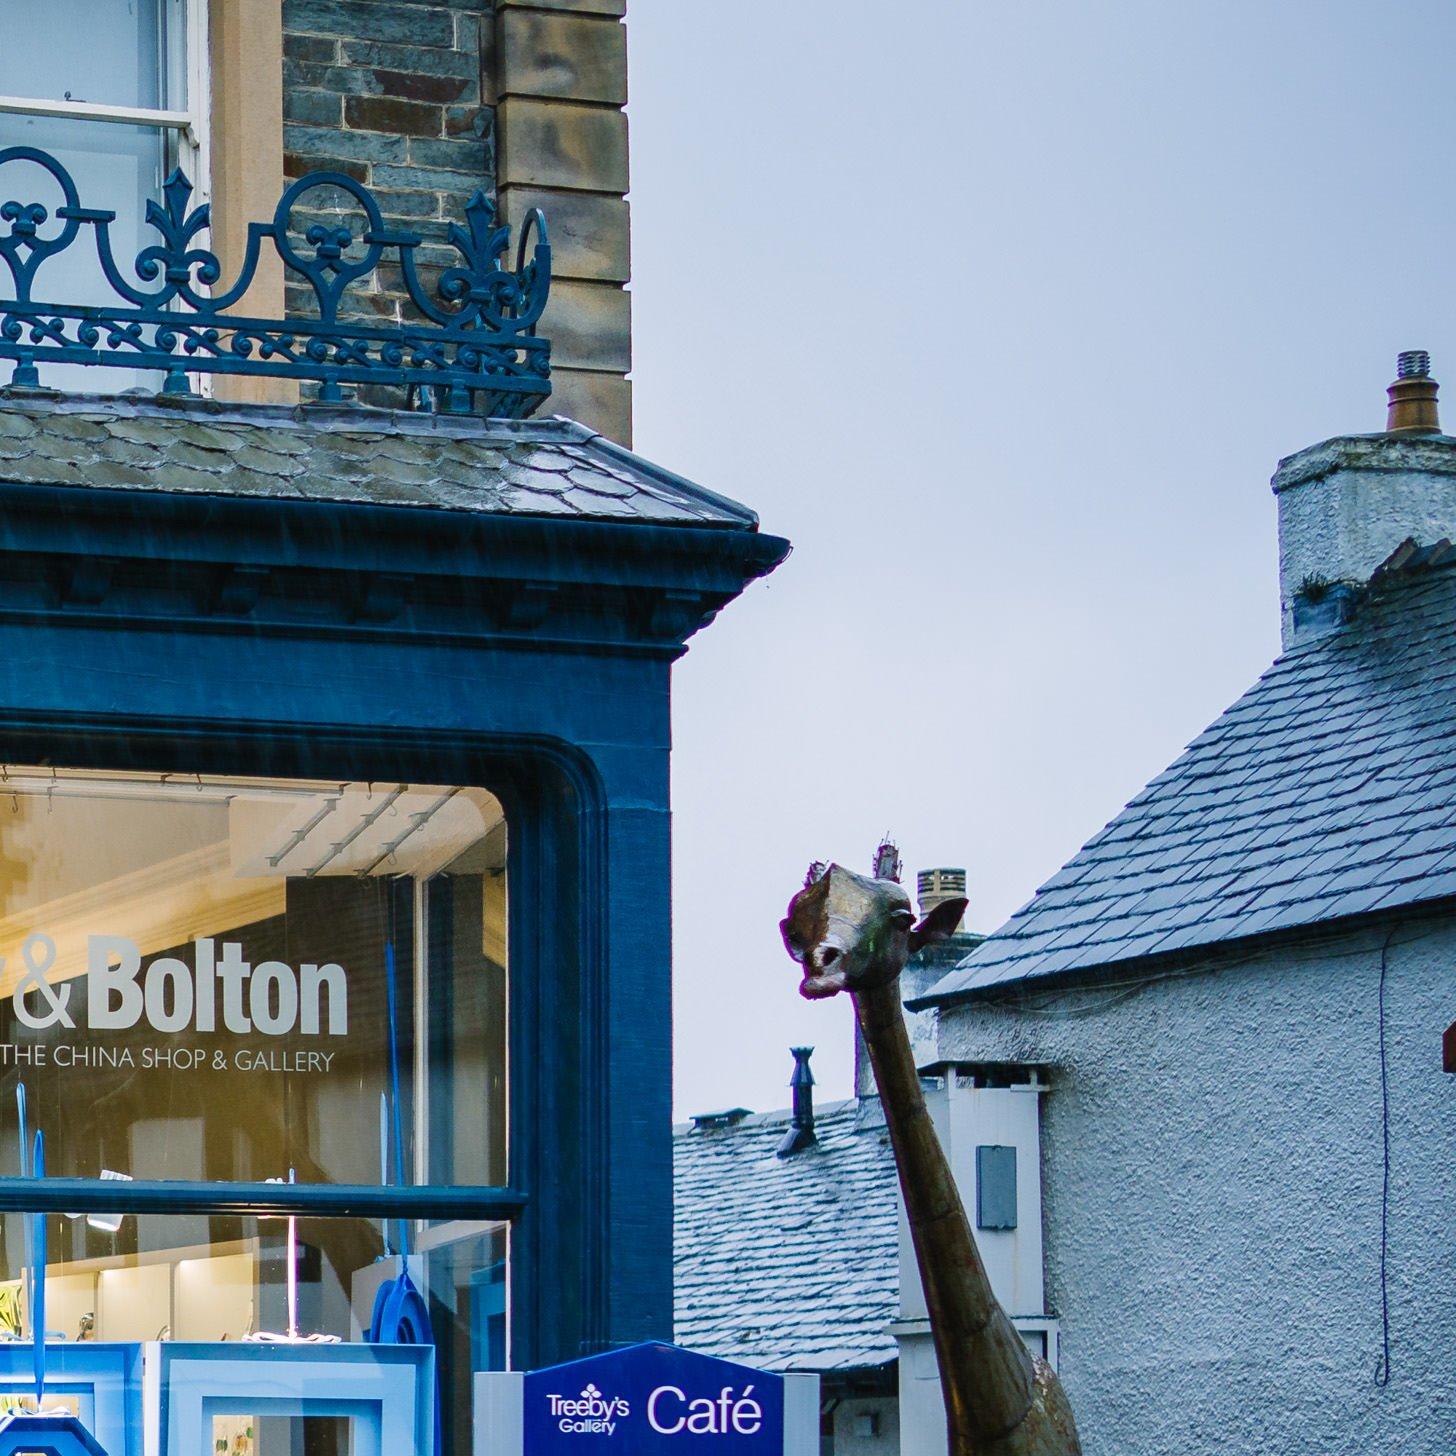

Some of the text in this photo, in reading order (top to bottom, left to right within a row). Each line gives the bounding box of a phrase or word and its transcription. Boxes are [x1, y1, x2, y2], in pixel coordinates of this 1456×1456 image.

[12, 932, 77, 1030] &
[87, 934, 348, 1036] Bolton
[53, 1045, 135, 1068] CHINA
[141, 1047, 206, 1070] SHOP
[212, 1051, 228, 1071] &
[234, 1050, 335, 1072] GALLERY
[546, 1385, 762, 1434] Treeby's Café
[559, 1418, 616, 1436] Gallery
